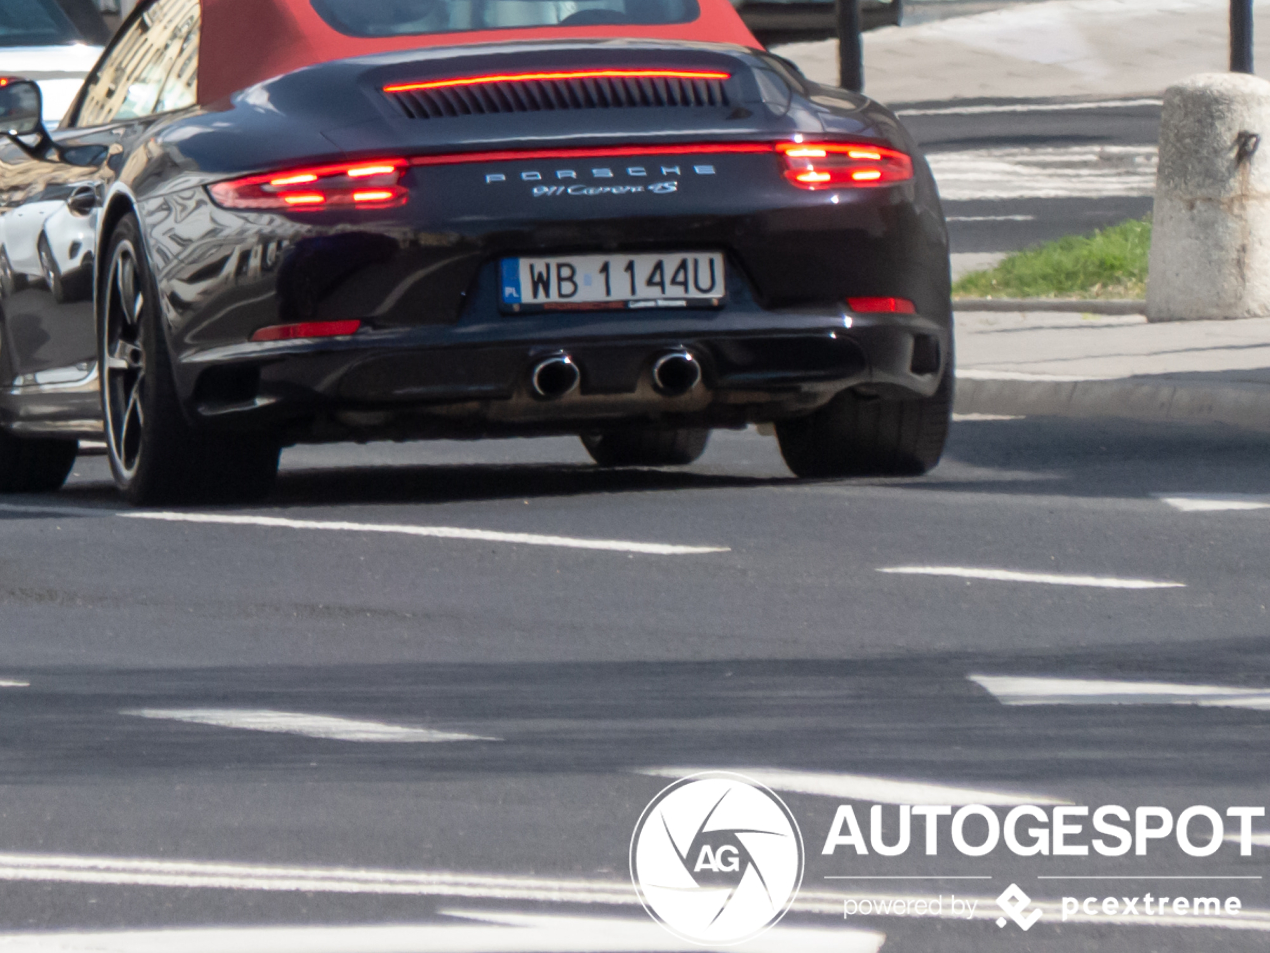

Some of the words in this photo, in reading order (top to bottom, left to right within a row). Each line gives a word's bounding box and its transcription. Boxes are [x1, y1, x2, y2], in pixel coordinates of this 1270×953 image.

[485, 165, 716, 184] PORSCHE
[504, 286, 519, 298] PL
[529, 261, 579, 300] WB
[599, 257, 717, 297] 1144U
